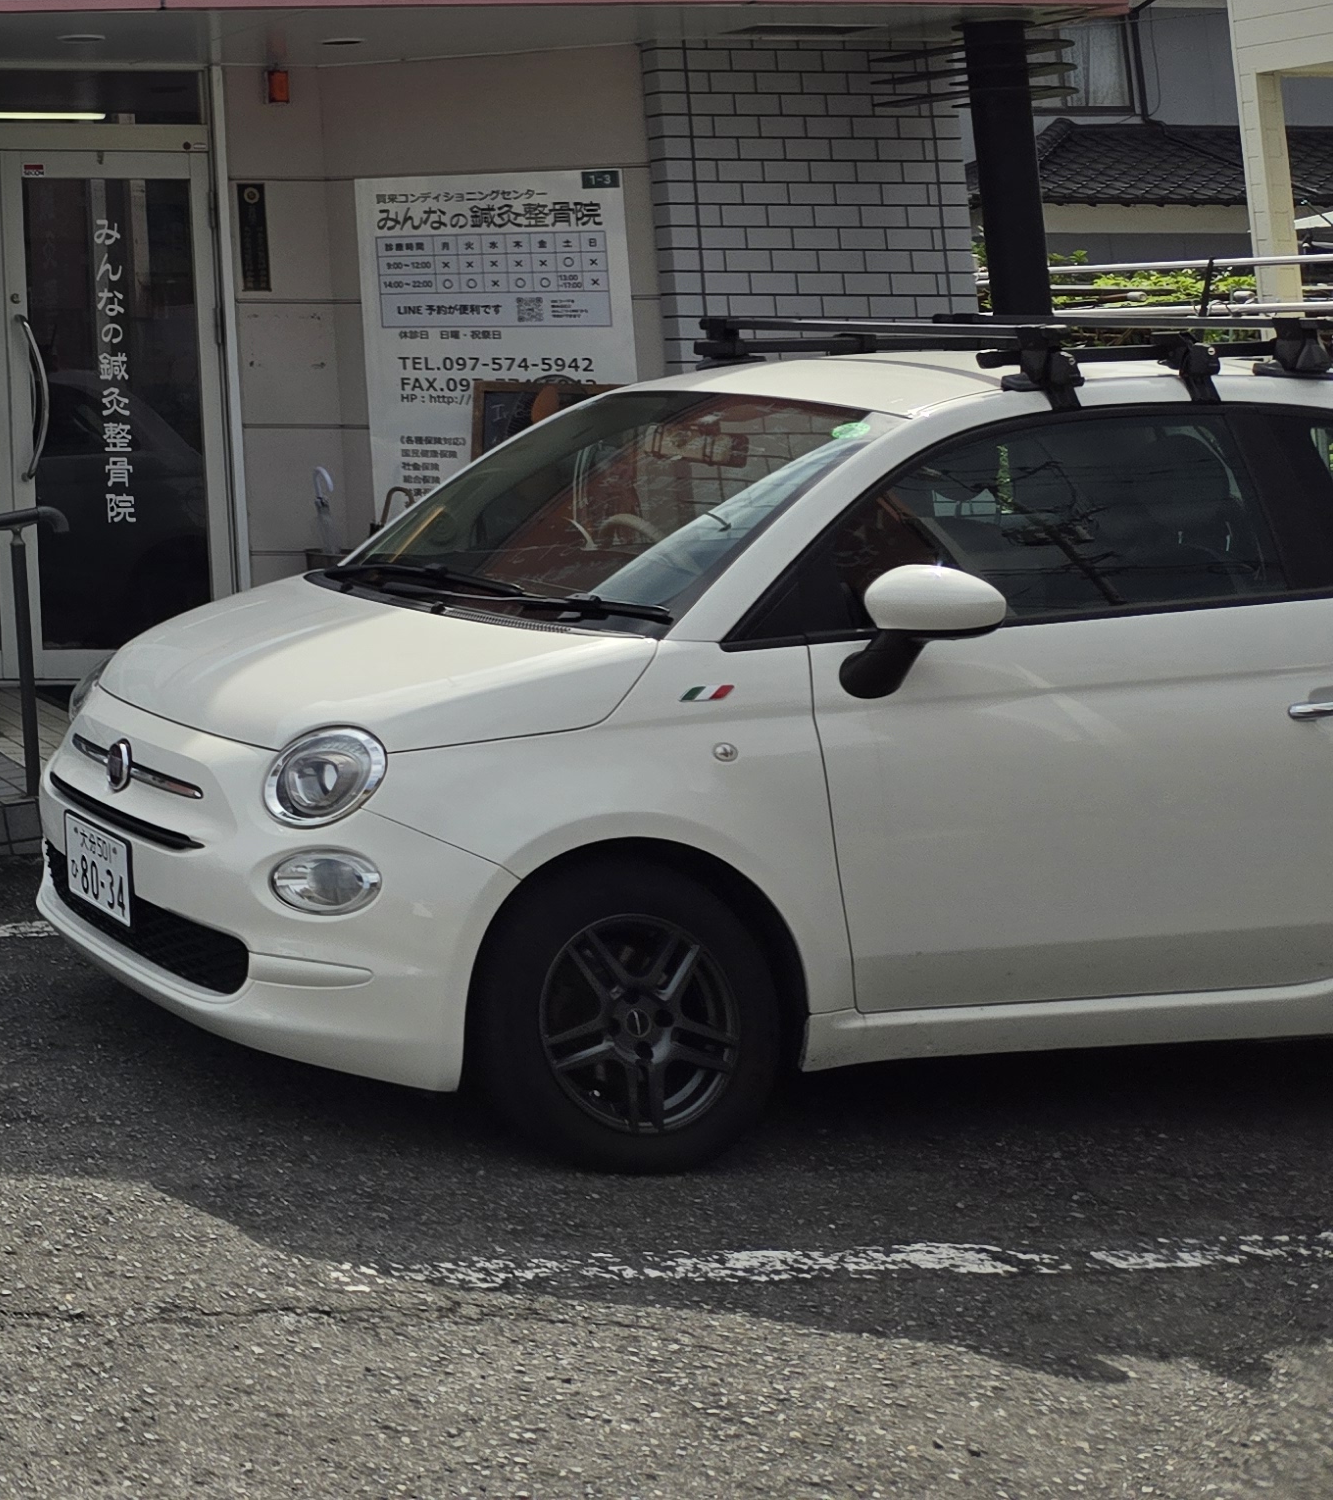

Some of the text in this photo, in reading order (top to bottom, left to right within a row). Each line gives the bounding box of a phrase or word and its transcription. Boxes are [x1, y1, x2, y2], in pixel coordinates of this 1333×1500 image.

[589, 174, 611, 185] 1-3
[377, 201, 603, 231] みんなの鍼灸整骨院
[397, 305, 423, 315] LINE
[93, 218, 137, 524] みんなの鍼灸整骨院
